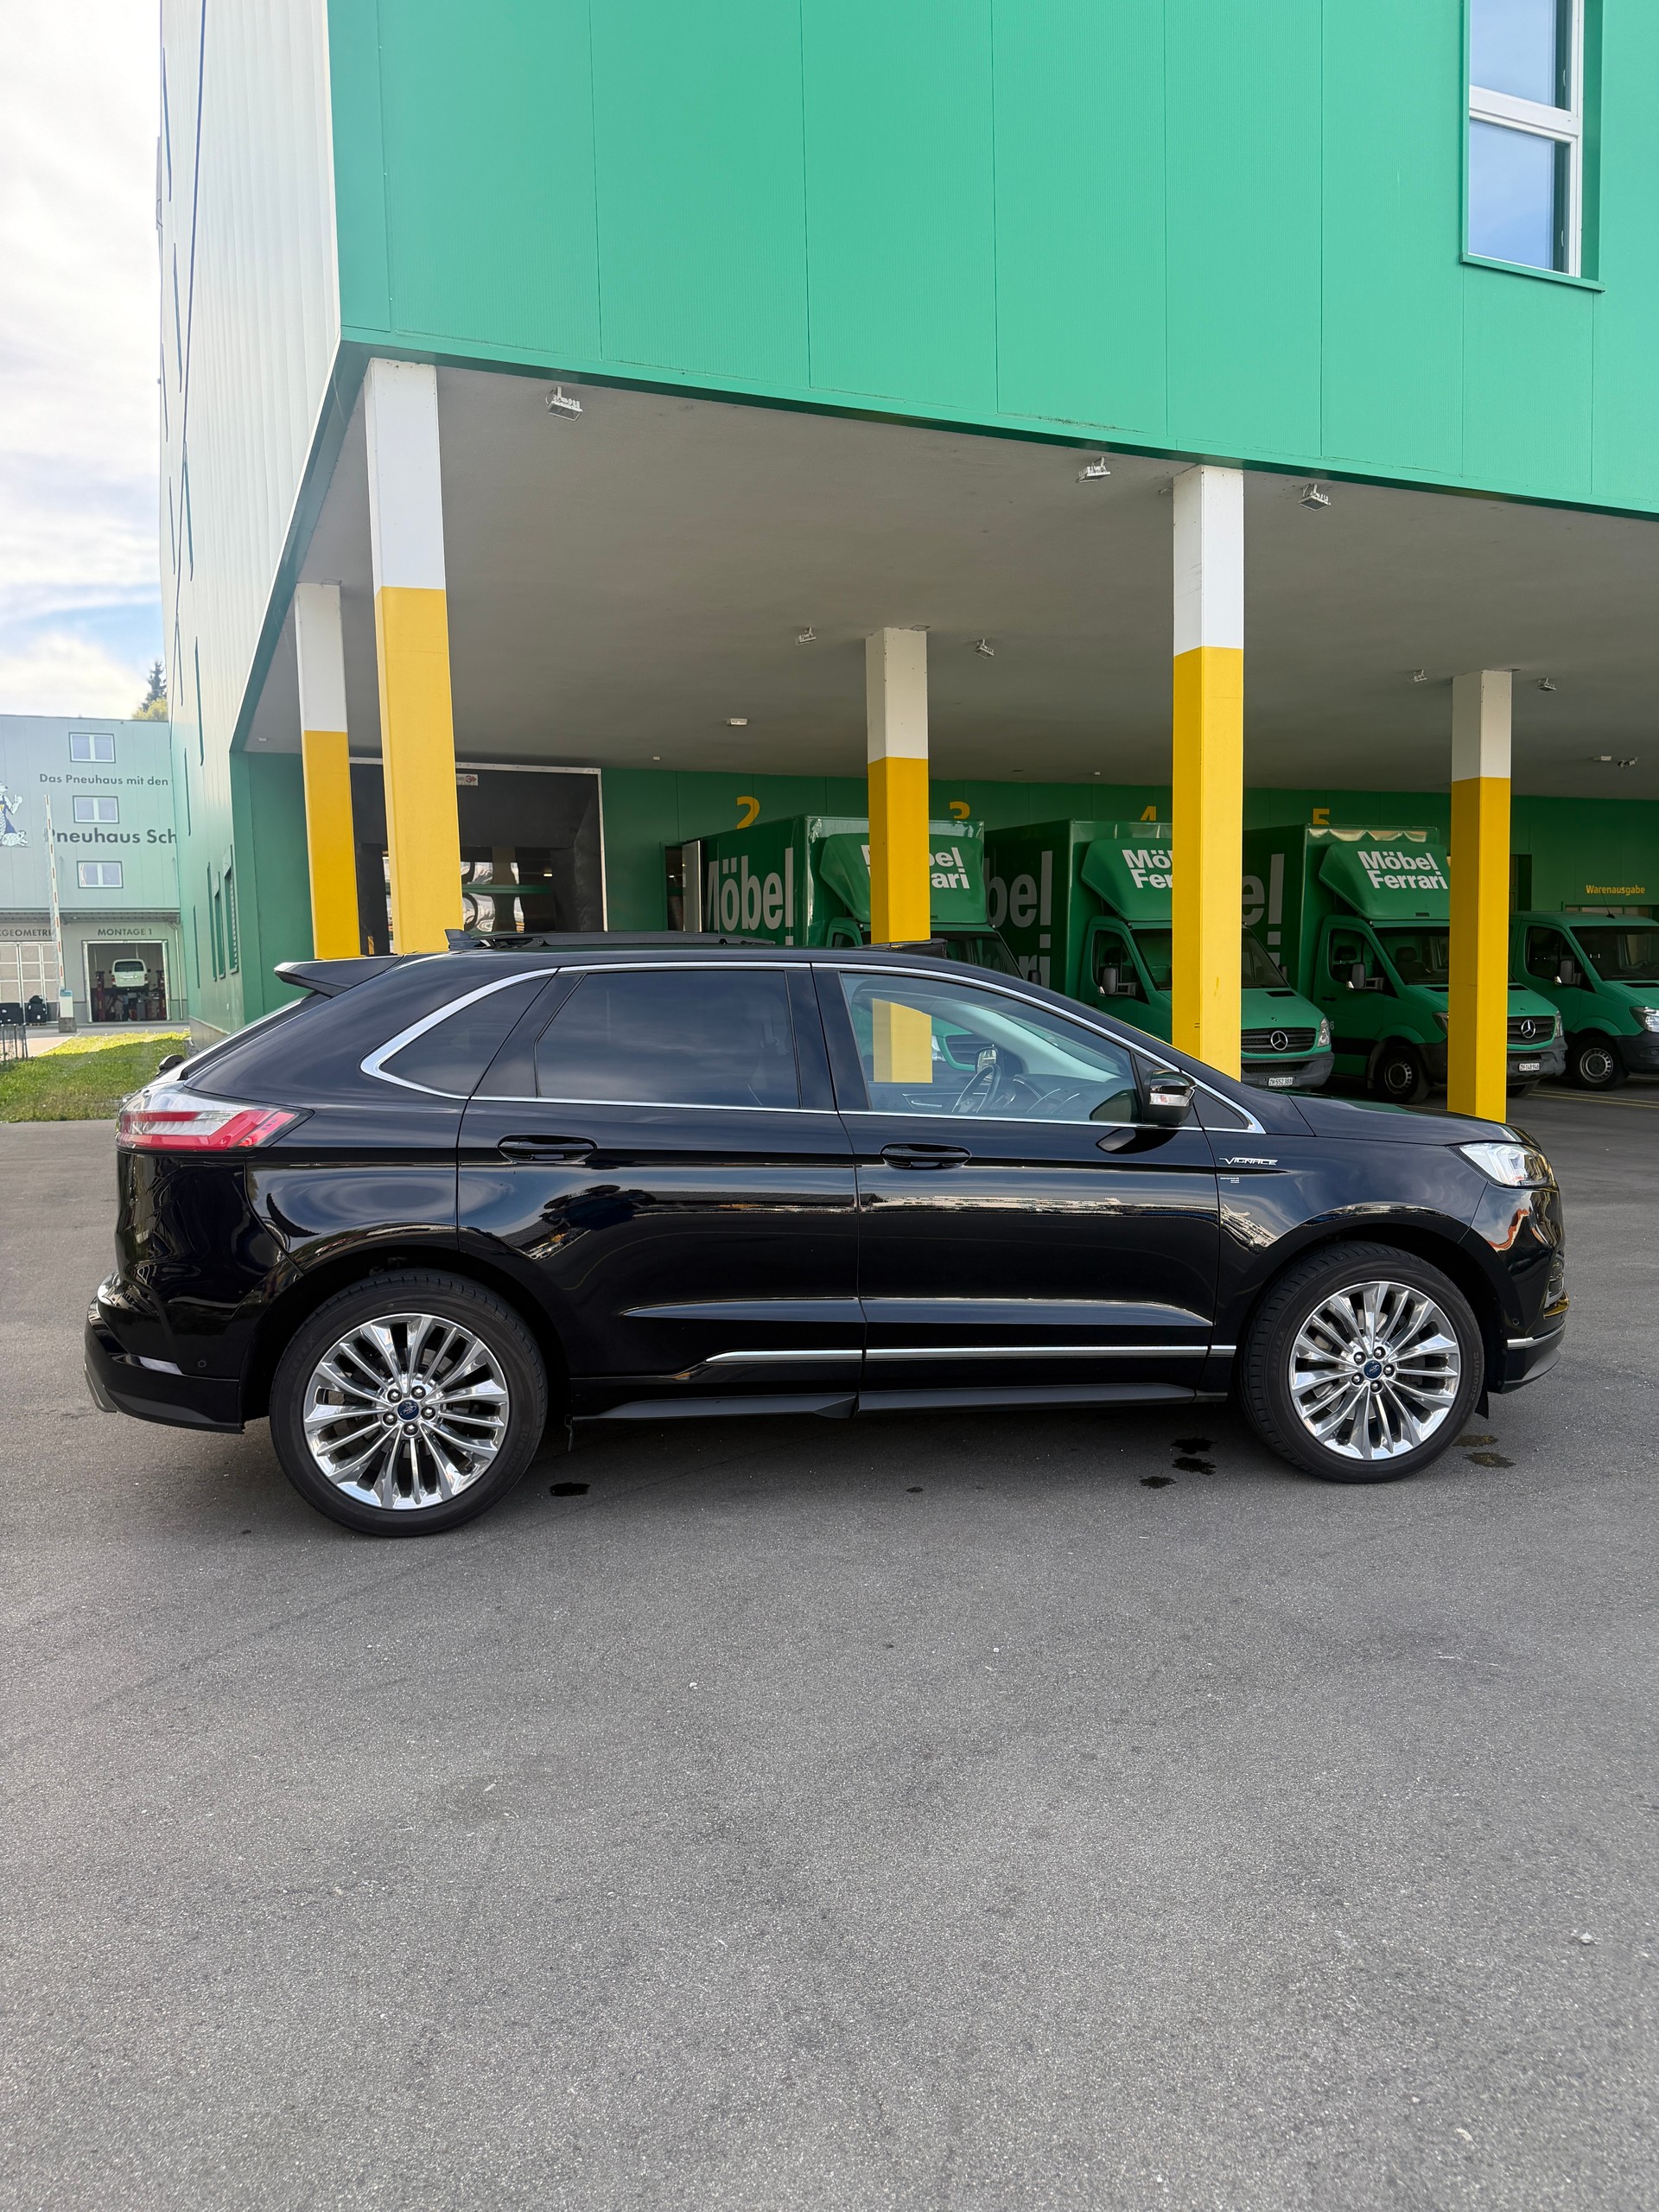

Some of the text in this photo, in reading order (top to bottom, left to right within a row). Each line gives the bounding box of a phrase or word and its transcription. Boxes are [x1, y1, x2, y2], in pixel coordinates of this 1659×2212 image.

[40, 774, 168, 785] Das Pneuhaus mit den
[736, 796, 760, 830] 2
[1357, 850, 1440, 871] Möbel
[1366, 869, 1449, 890] Ferrari
[1586, 884, 1646, 896] Warenausgabe
